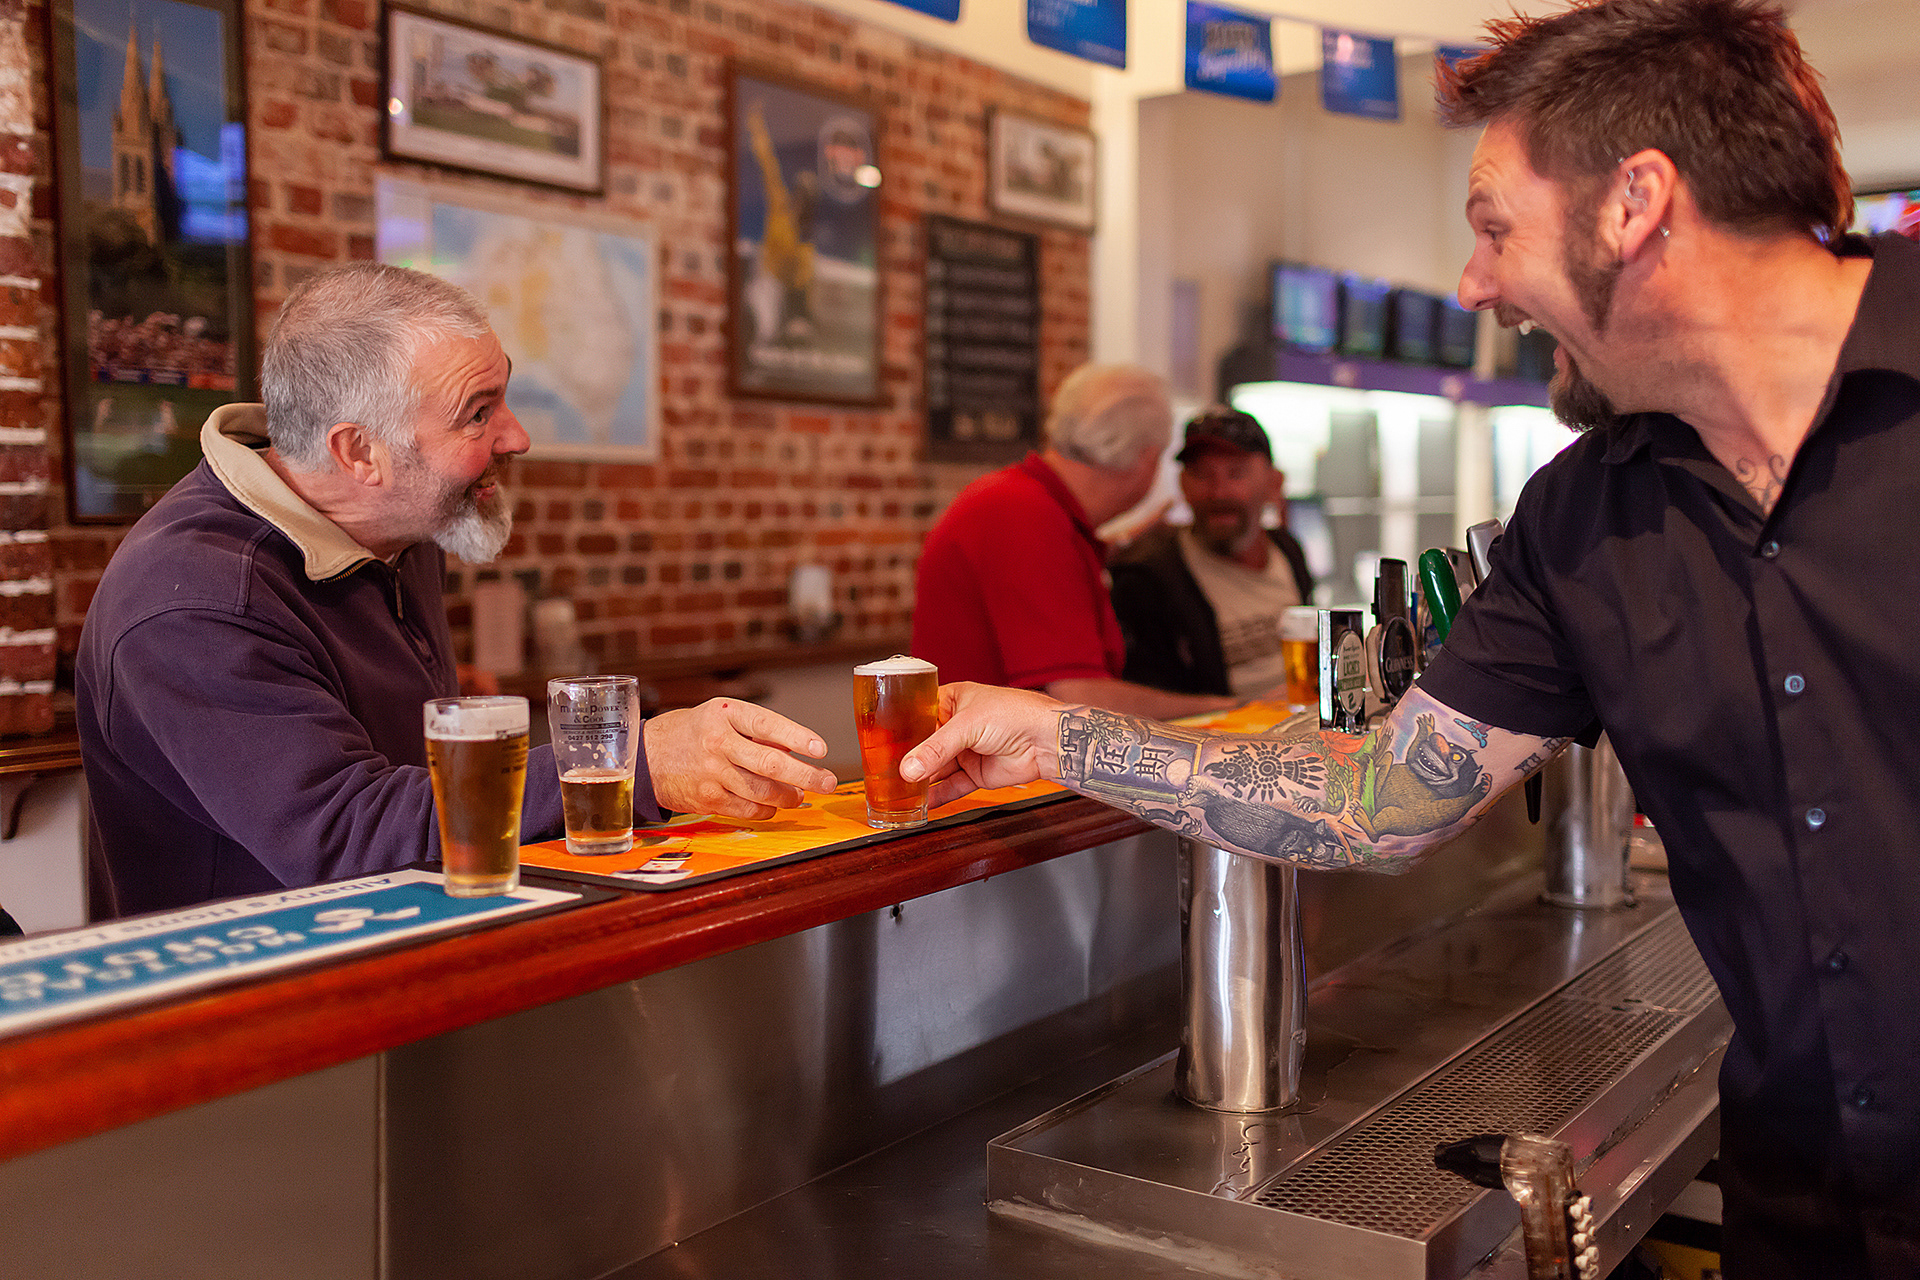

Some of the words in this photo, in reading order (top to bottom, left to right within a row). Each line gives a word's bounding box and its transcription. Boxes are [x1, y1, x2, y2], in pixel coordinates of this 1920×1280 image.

[574, 715, 582, 724] &
[246, 877, 392, 908] Albany's
[120, 907, 239, 934] Home
